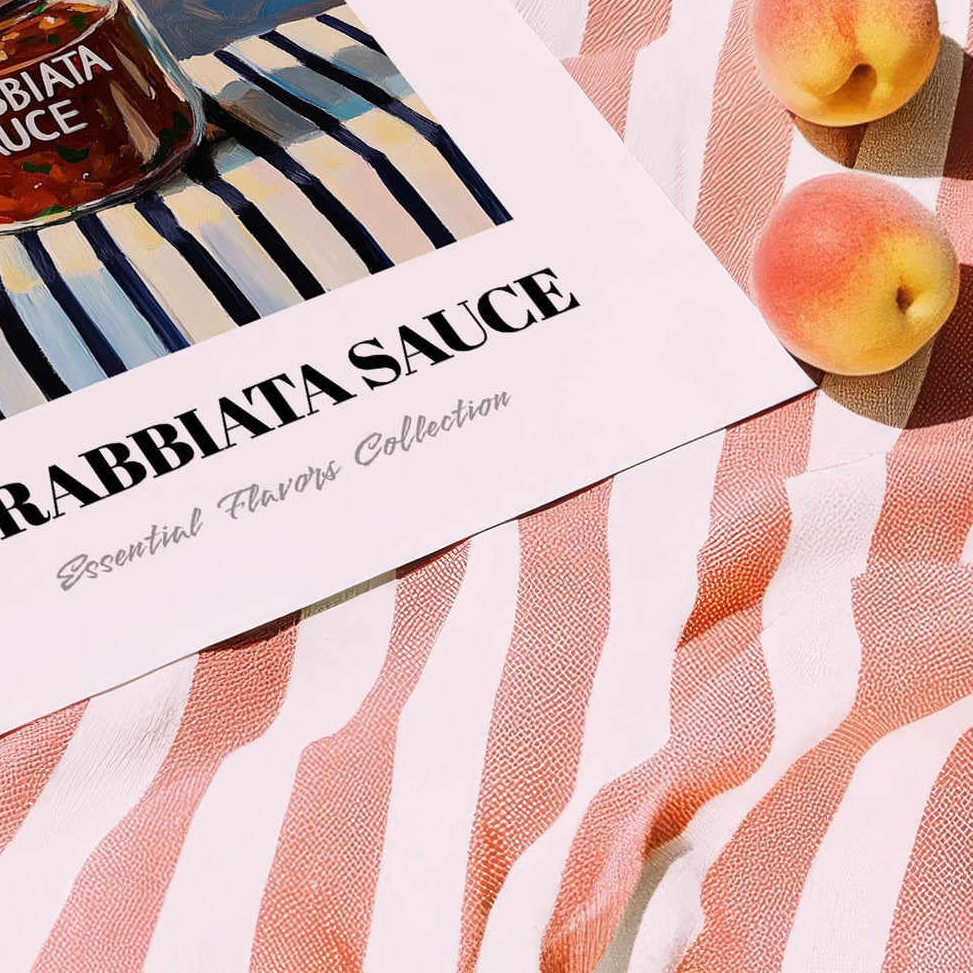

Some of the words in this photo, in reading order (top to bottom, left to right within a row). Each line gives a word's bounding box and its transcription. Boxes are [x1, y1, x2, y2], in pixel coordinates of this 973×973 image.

[347, 267, 581, 390] SAUCE
[56, 507, 203, 591] Essential
[217, 459, 342, 520] Flavors
[354, 390, 512, 467] Collection
